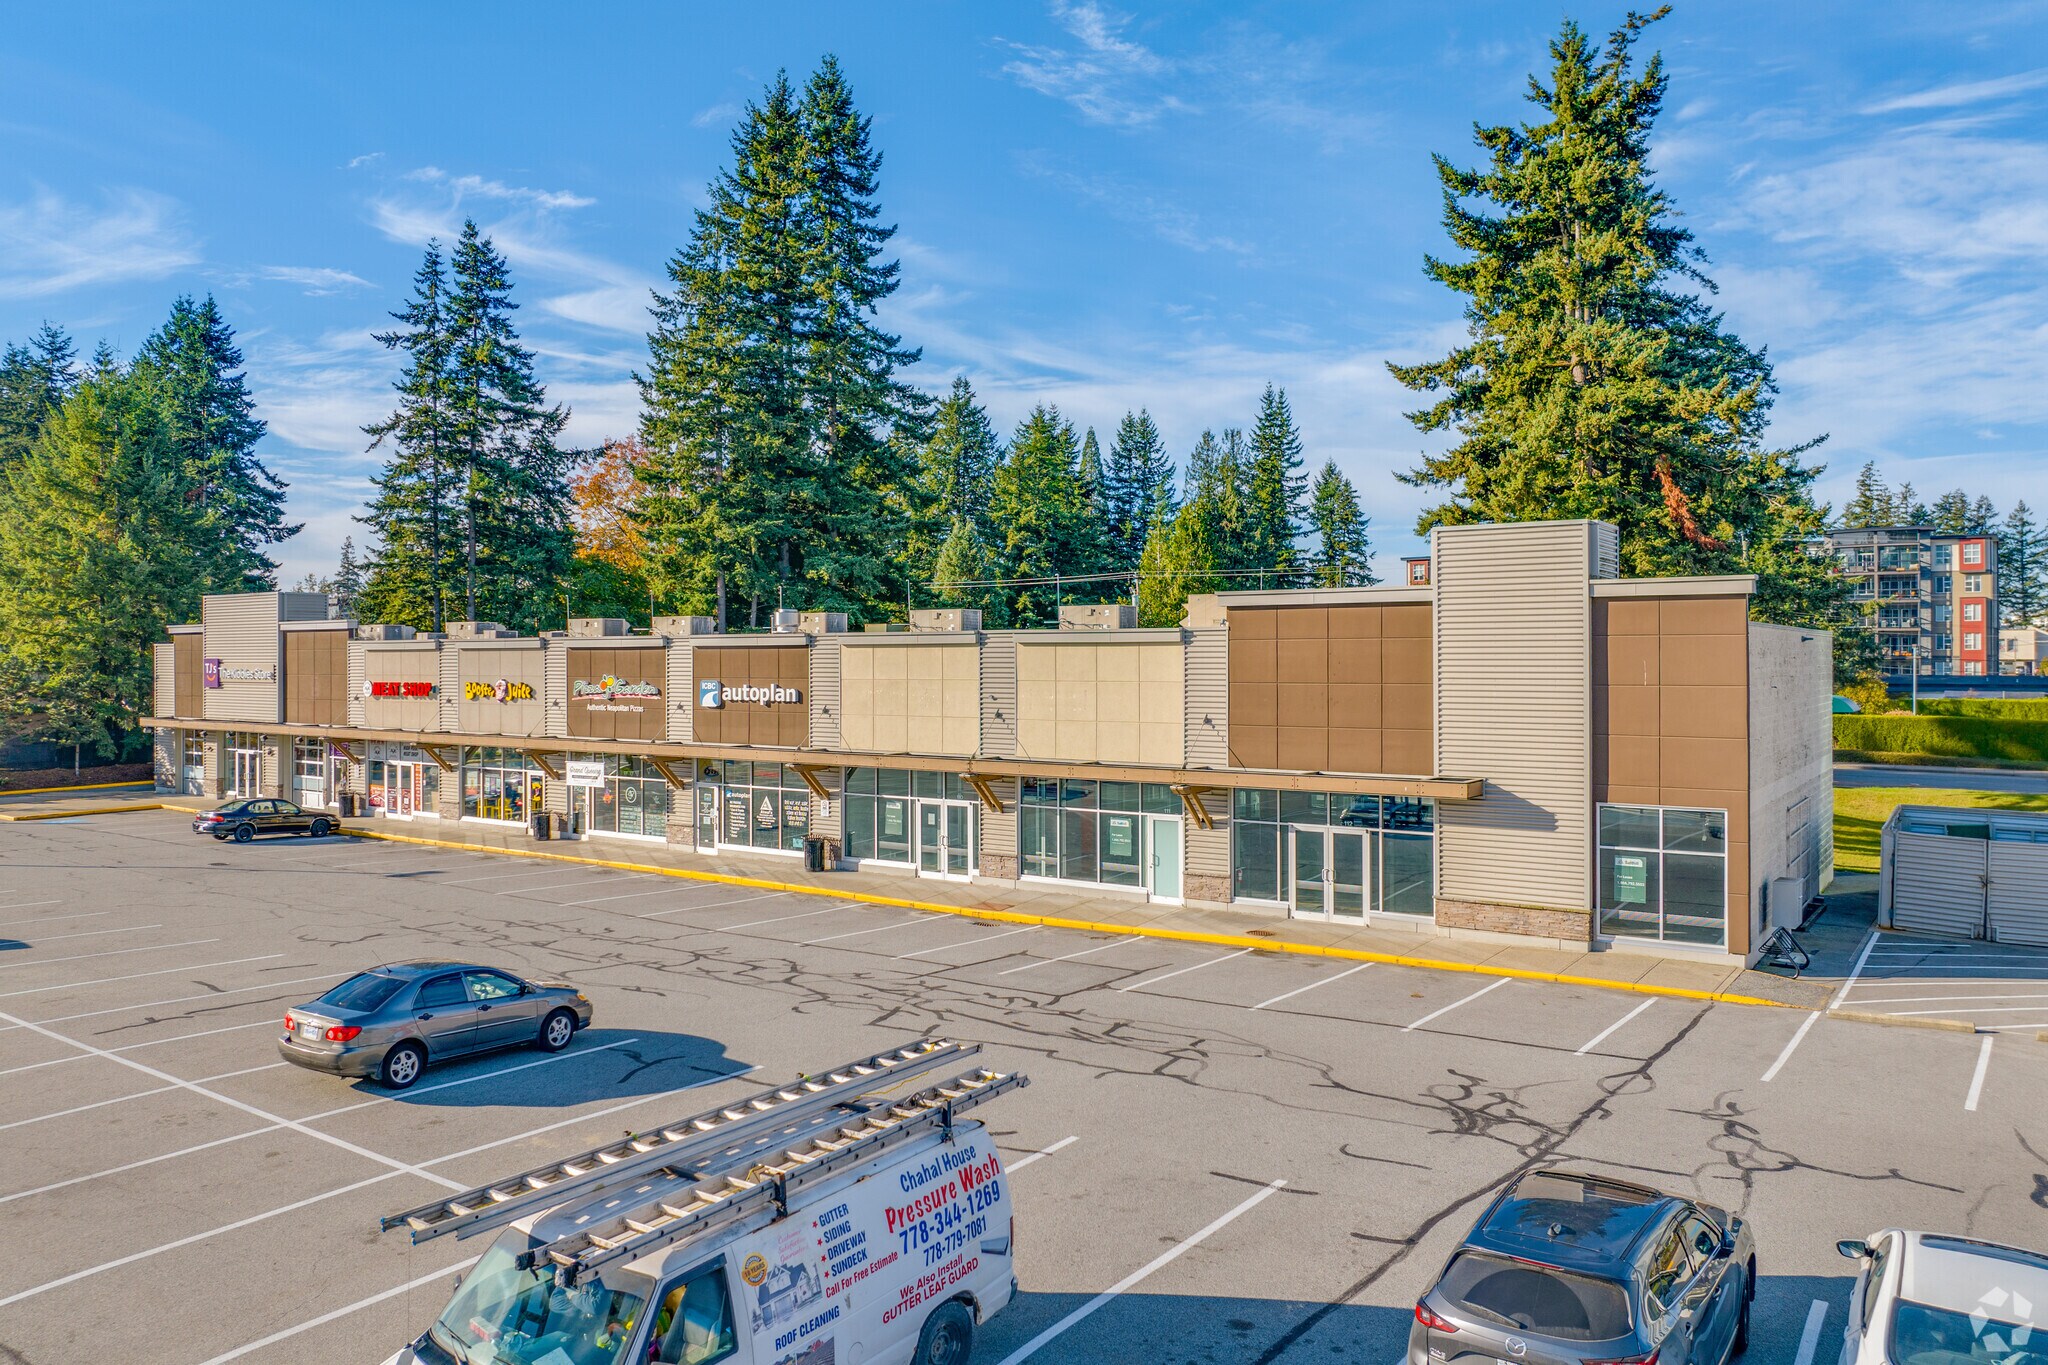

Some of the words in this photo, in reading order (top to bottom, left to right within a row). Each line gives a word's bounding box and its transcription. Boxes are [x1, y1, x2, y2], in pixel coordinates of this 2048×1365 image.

[372, 682, 401, 696] MEAT
[402, 682, 432, 697] SHOP
[465, 682, 496, 700] Booster
[505, 682, 532, 701] Juice
[573, 680, 602, 696] Pizza
[615, 679, 657, 695] Garden
[701, 682, 716, 690] ICBC
[721, 683, 799, 706] autoplan
[586, 703, 607, 712] Authentic
[900, 1158, 943, 1193] Chahal
[942, 1145, 977, 1172] House
[885, 1181, 957, 1234] Pressure
[958, 1153, 1000, 1192] Wash
[818, 1203, 849, 1228] GUTTER
[899, 1180, 1001, 1255] 778-344-1269
[823, 1220, 852, 1244] SIDING
[827, 1229, 867, 1261] DRIVEWAY
[923, 1215, 987, 1267] 778-779-7081
[826, 1281, 840, 1298] Call
[841, 1277, 853, 1290] For
[853, 1267, 869, 1283] Free
[869, 1251, 899, 1274] Estimate
[831, 1247, 868, 1277] SUNDECK
[900, 1285, 914, 1300] We
[916, 1273, 936, 1291] Also
[937, 1253, 963, 1278] Install
[882, 1292, 922, 1324] GUTTER
[923, 1277, 947, 1301] LEAF
[948, 1257, 979, 1285] GUARD
[775, 1328, 797, 1352] ROOF
[799, 1305, 840, 1338] CLEANING
